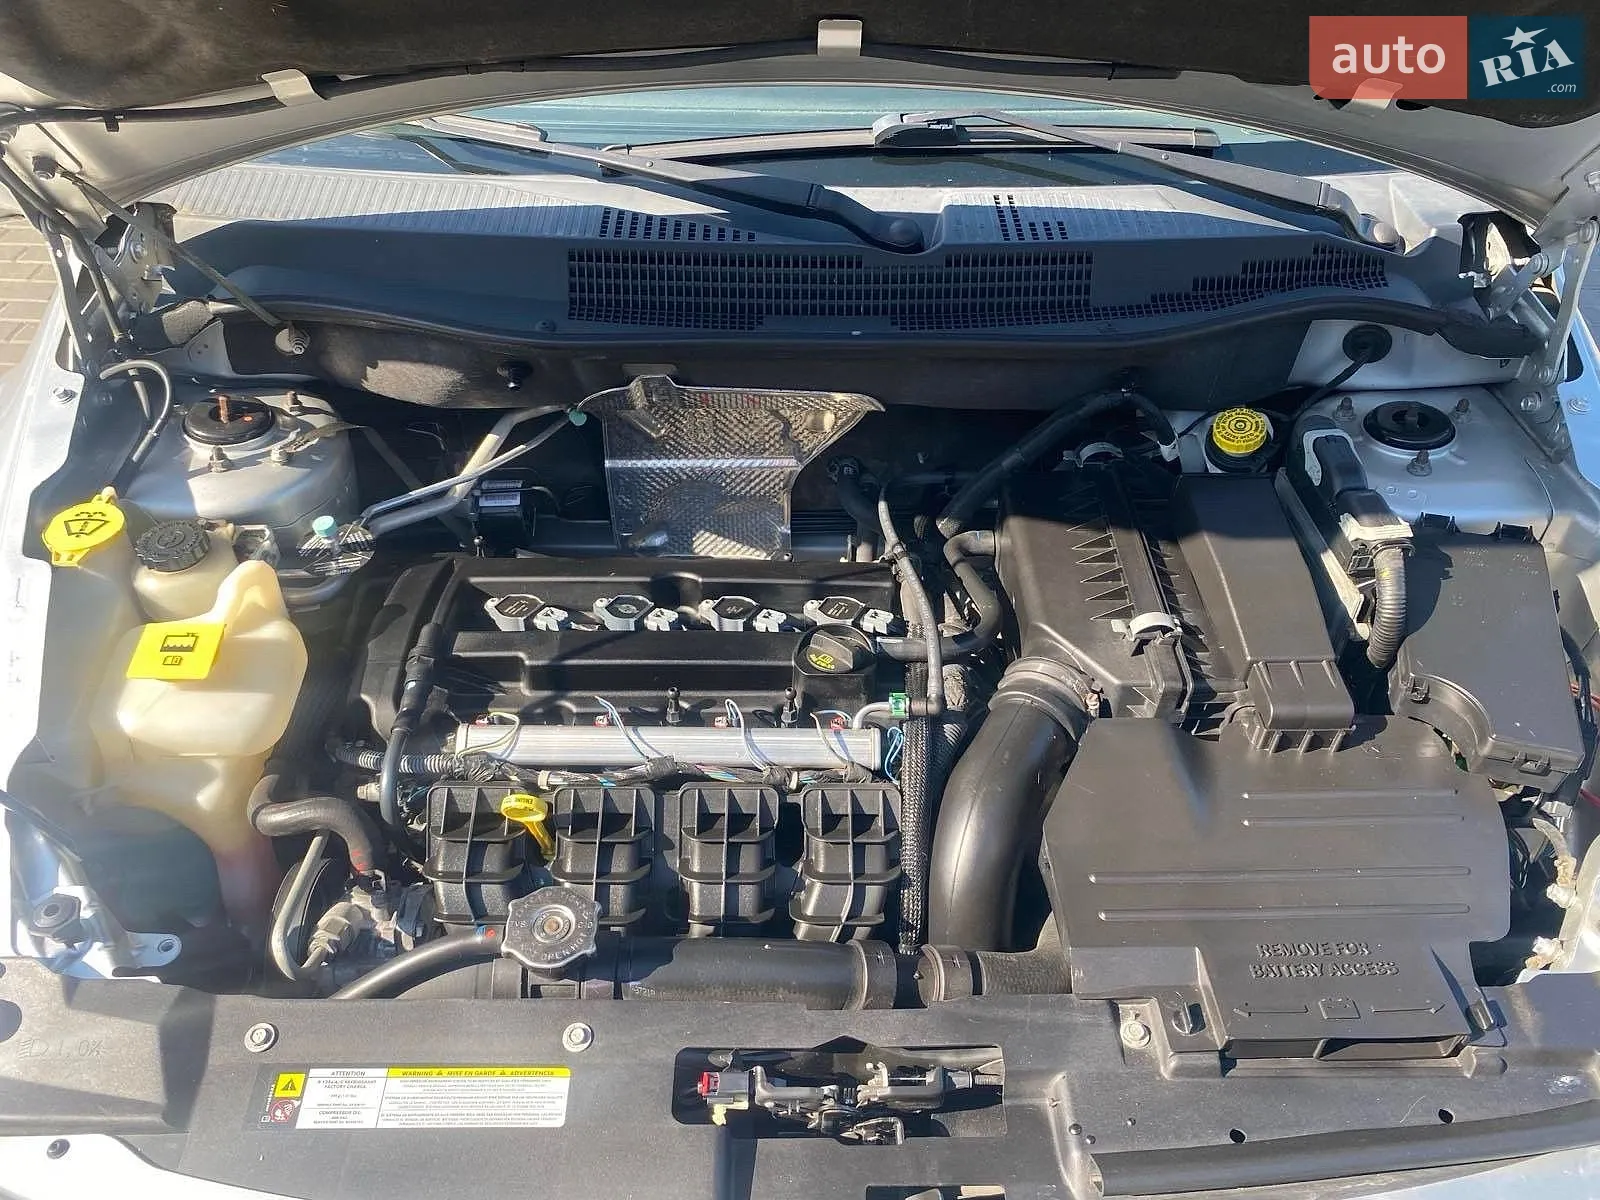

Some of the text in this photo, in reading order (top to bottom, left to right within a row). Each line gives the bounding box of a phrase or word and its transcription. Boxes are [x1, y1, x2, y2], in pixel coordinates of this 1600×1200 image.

[1256, 941, 1369, 958] REMOVE FOR
[1249, 961, 1400, 979] BATTERY ACCESS
